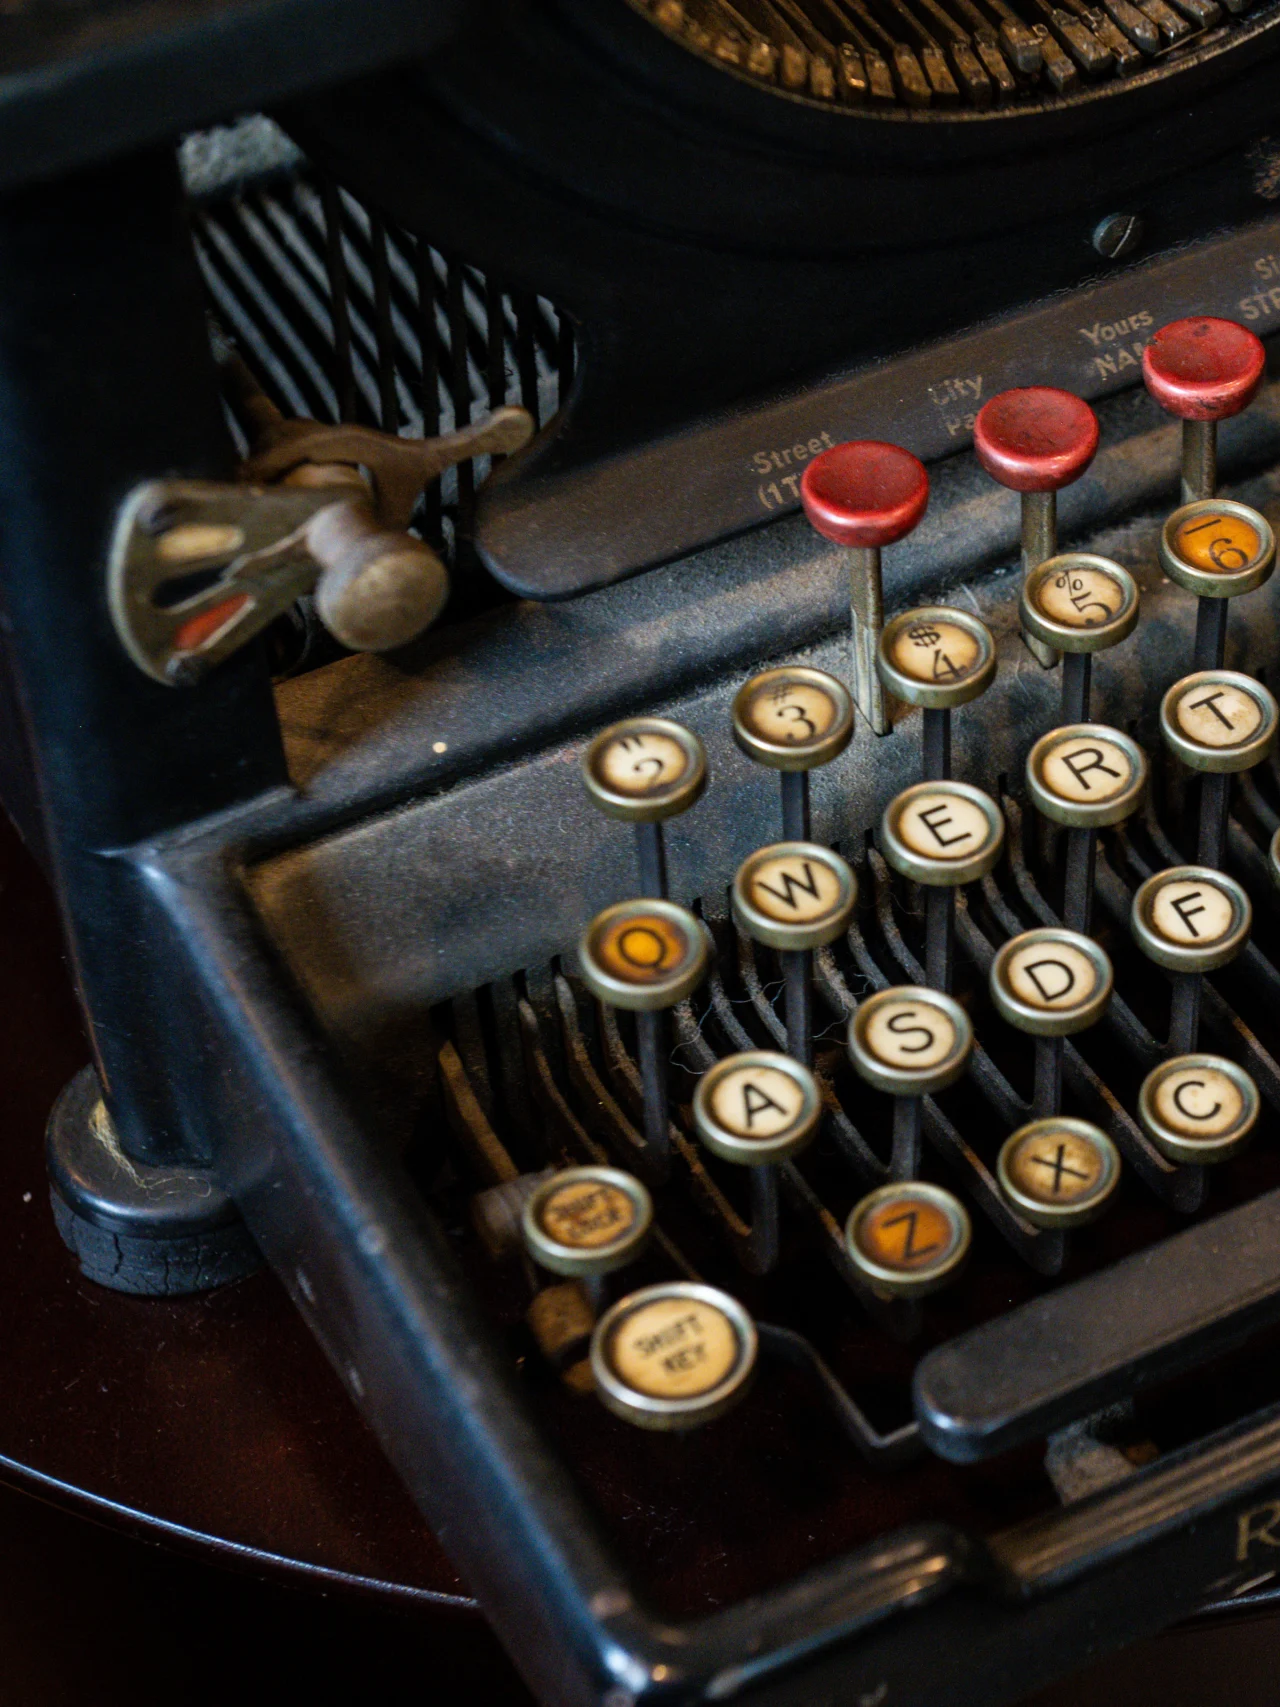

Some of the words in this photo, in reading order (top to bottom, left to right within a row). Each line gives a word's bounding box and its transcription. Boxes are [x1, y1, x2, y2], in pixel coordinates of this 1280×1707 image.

[1079, 310, 1154, 346] Yours
[752, 430, 836, 475] Street
[1209, 537, 1248, 571] 6
[1071, 591, 1114, 626] 5
[908, 623, 942, 648] $
[931, 649, 968, 681] 4
[777, 705, 816, 741] 3
[1189, 692, 1236, 731] T
[1062, 747, 1121, 790] R
[918, 804, 972, 847] E
[759, 863, 821, 910] W
[1171, 891, 1206, 938] F
[615, 926, 674, 974] Q
[1024, 959, 1075, 1001] D
[887, 1012, 934, 1053] S
[741, 1082, 788, 1129] A
[1173, 1080, 1222, 1121] C
[1031, 1144, 1091, 1195] X
[882, 1211, 939, 1261] Z
